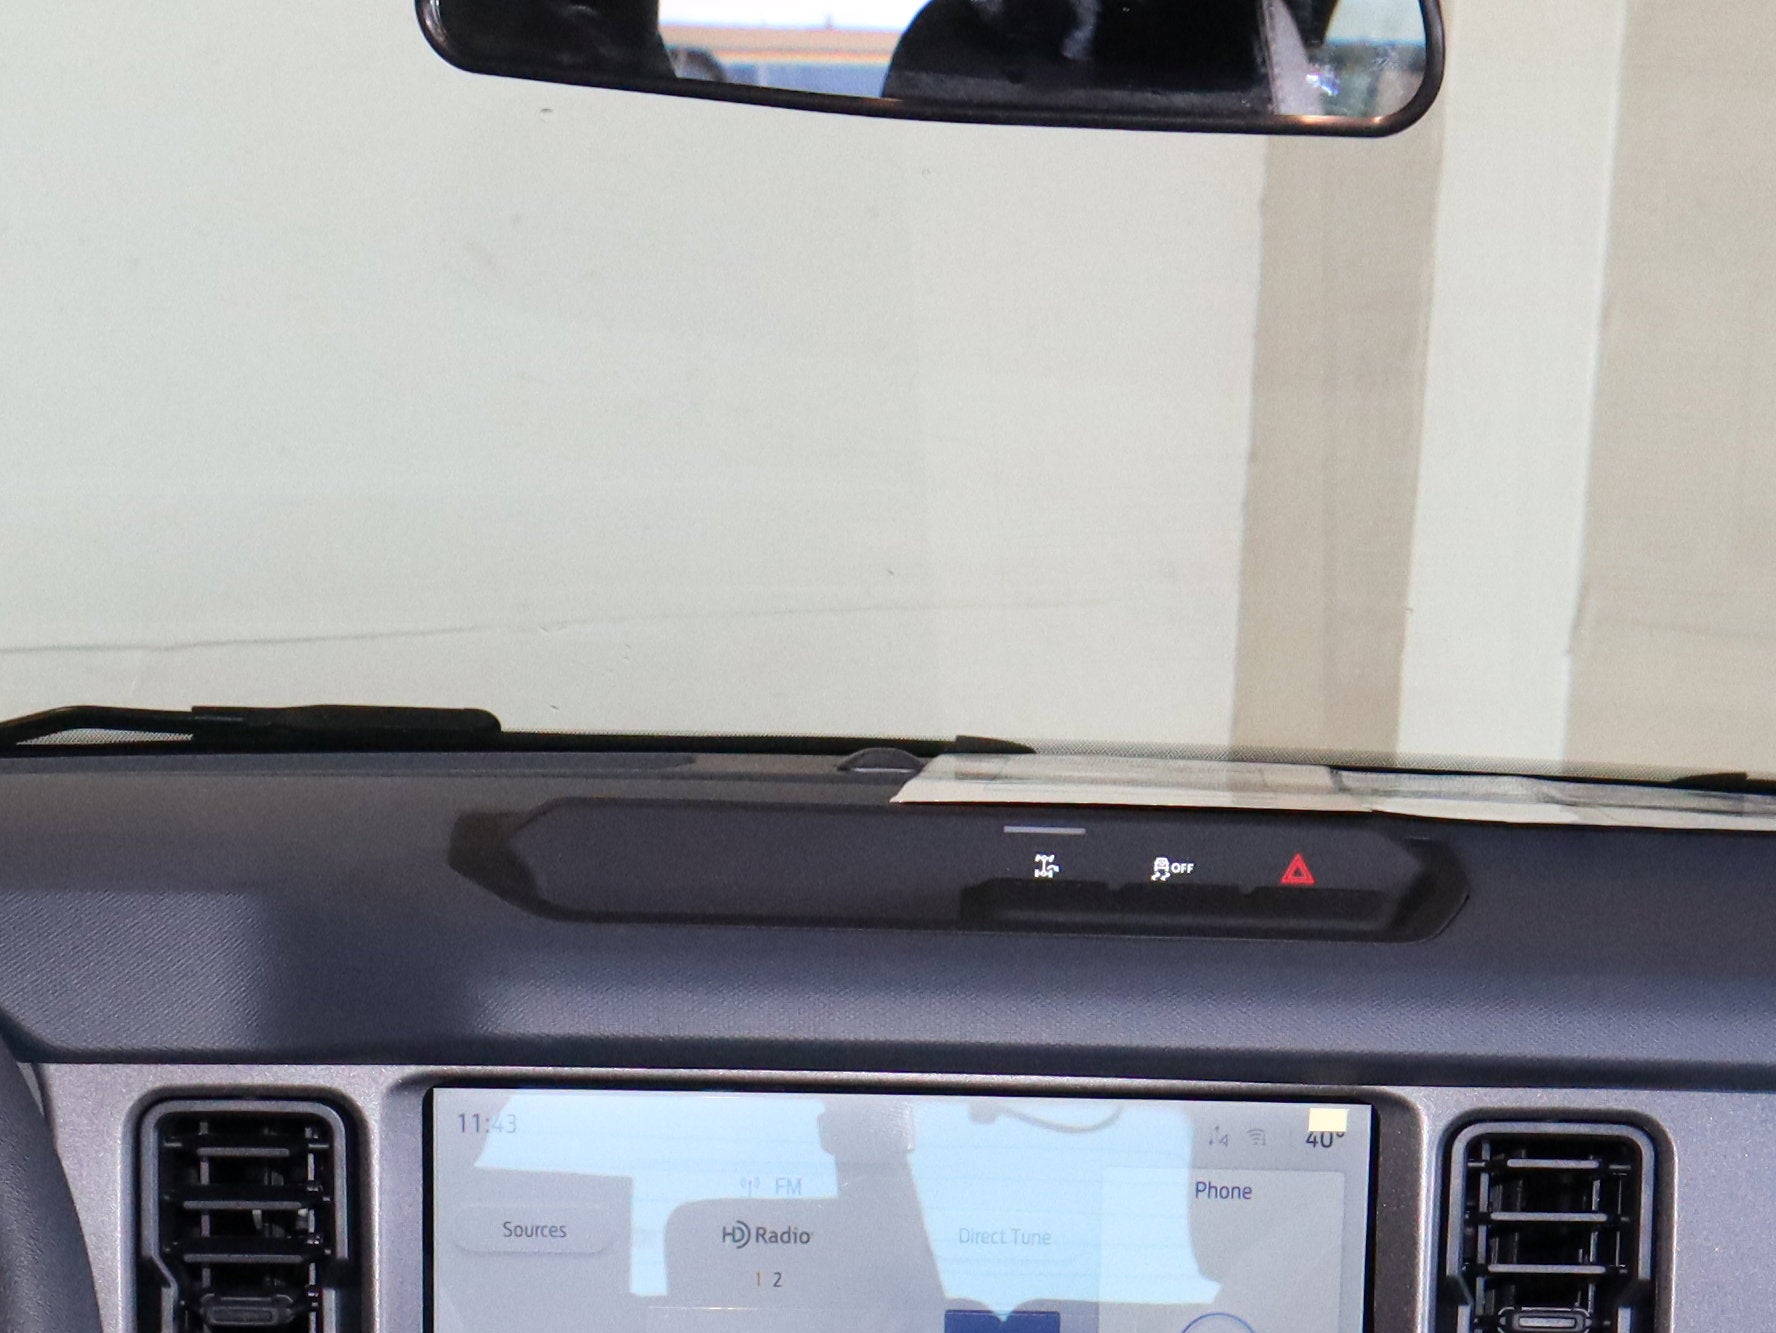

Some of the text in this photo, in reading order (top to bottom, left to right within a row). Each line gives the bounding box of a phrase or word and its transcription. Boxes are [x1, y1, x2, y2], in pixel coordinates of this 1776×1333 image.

[1171, 862, 1194, 873] OFF
[457, 1113, 517, 1133] 11:43
[775, 1177, 802, 1195] FM
[1195, 1181, 1253, 1201] Phone
[503, 1220, 567, 1239] Sources
[755, 1225, 811, 1245] Radio
[958, 1227, 1052, 1246] Direct Tune
[755, 1271, 782, 1287] 1 2
